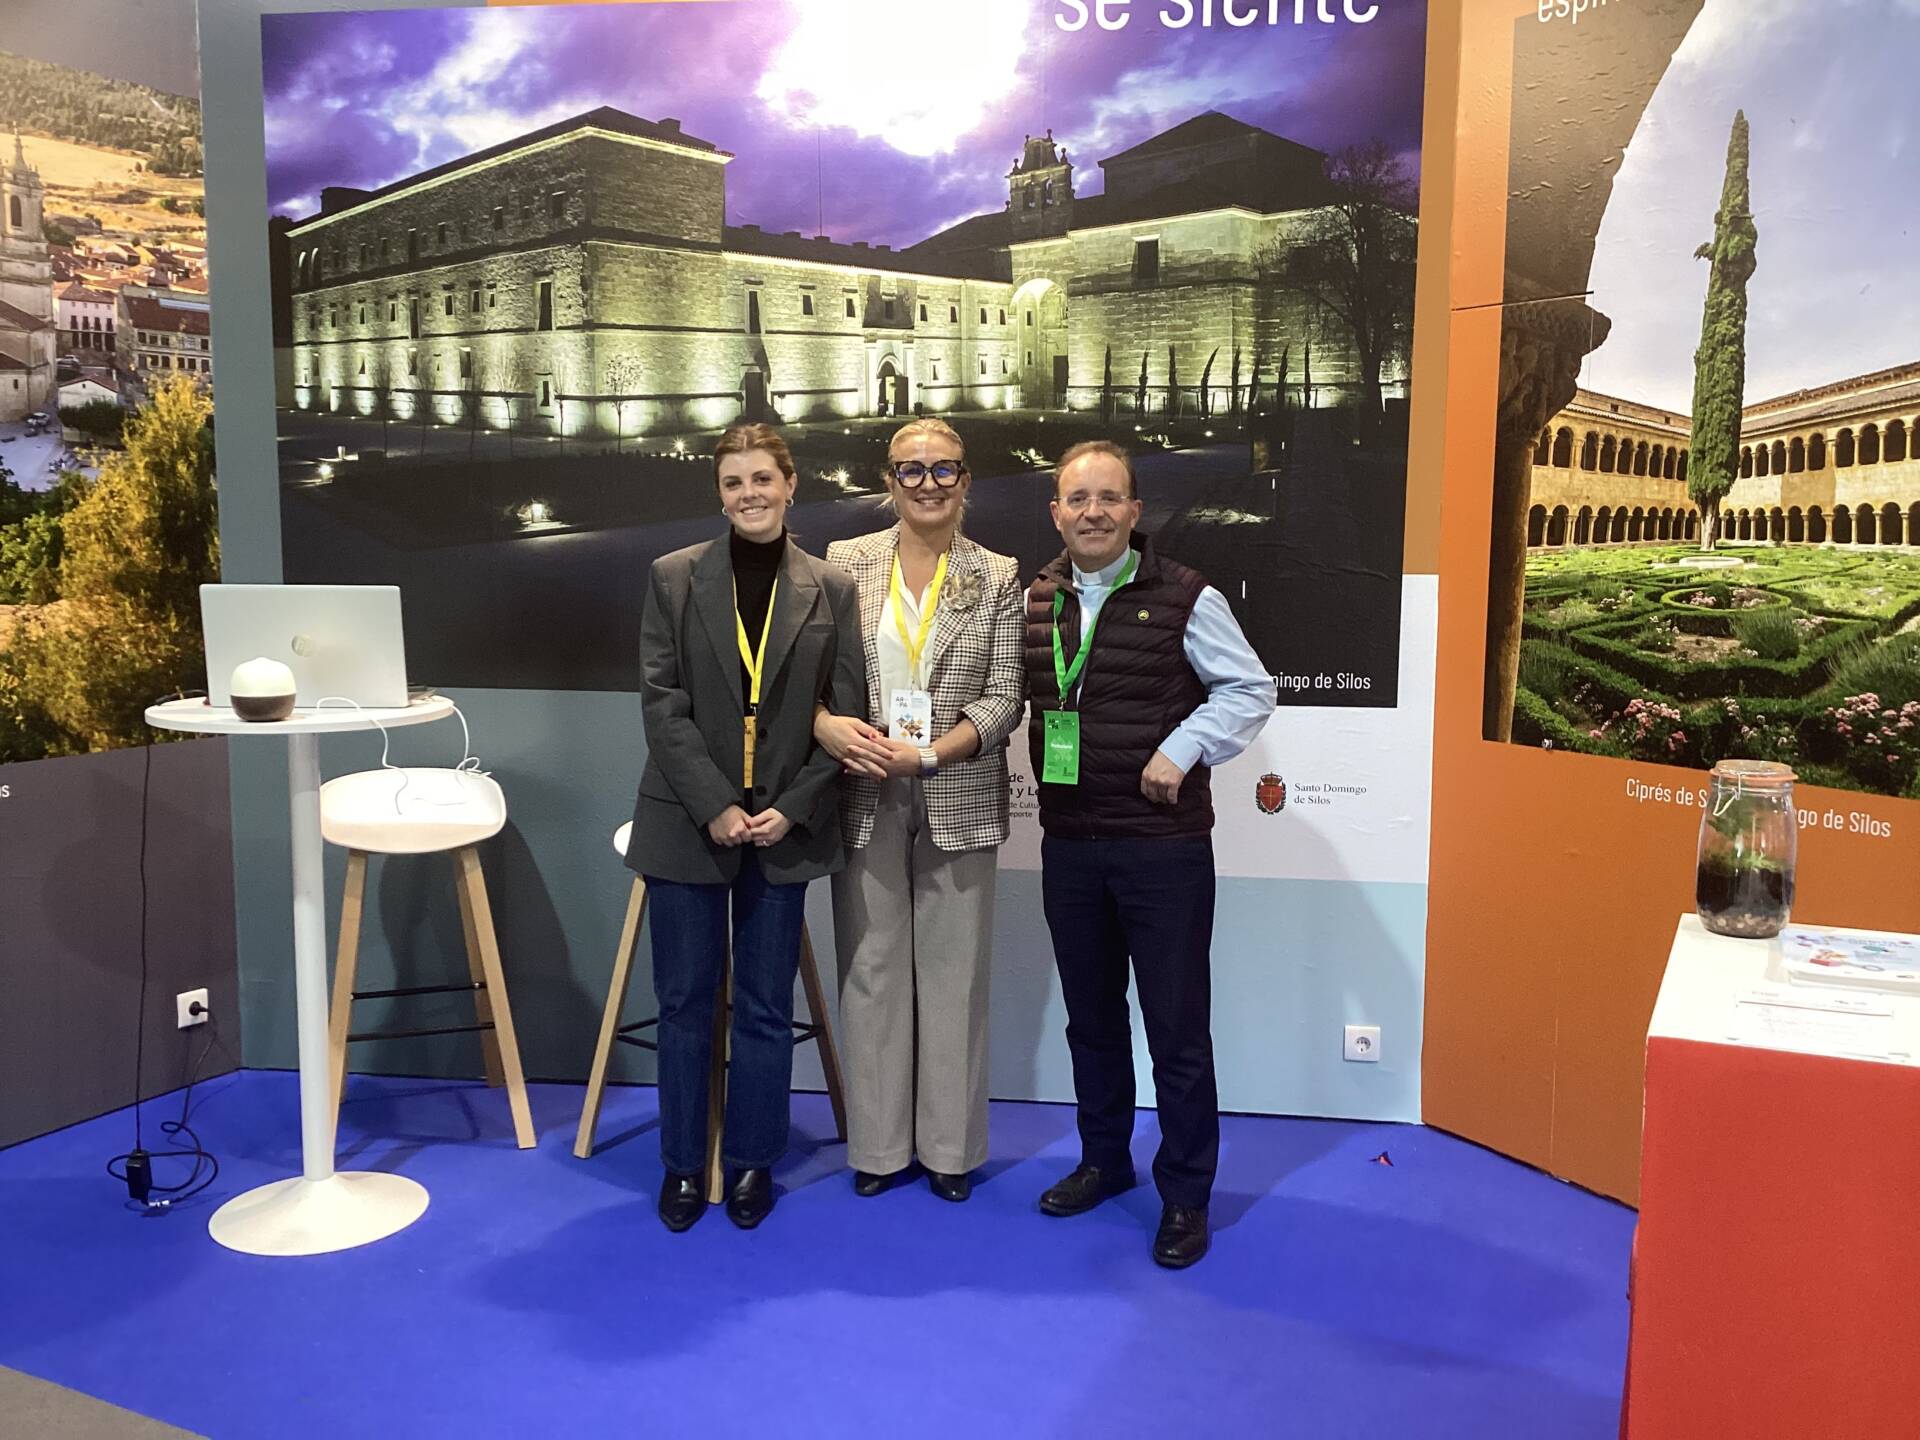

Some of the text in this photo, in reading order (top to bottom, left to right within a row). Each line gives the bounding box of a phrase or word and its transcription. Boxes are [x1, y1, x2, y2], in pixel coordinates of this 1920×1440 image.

[1314, 673, 1332, 688] de
[1336, 673, 1371, 689] Silos
[1294, 783, 1367, 796] Santo Domingo
[1626, 778, 1672, 803] Ciprés
[1675, 786, 1694, 806] de
[1294, 795, 1331, 805] de Silos
[1823, 809, 1844, 831] de
[1849, 812, 1892, 837] Silos
